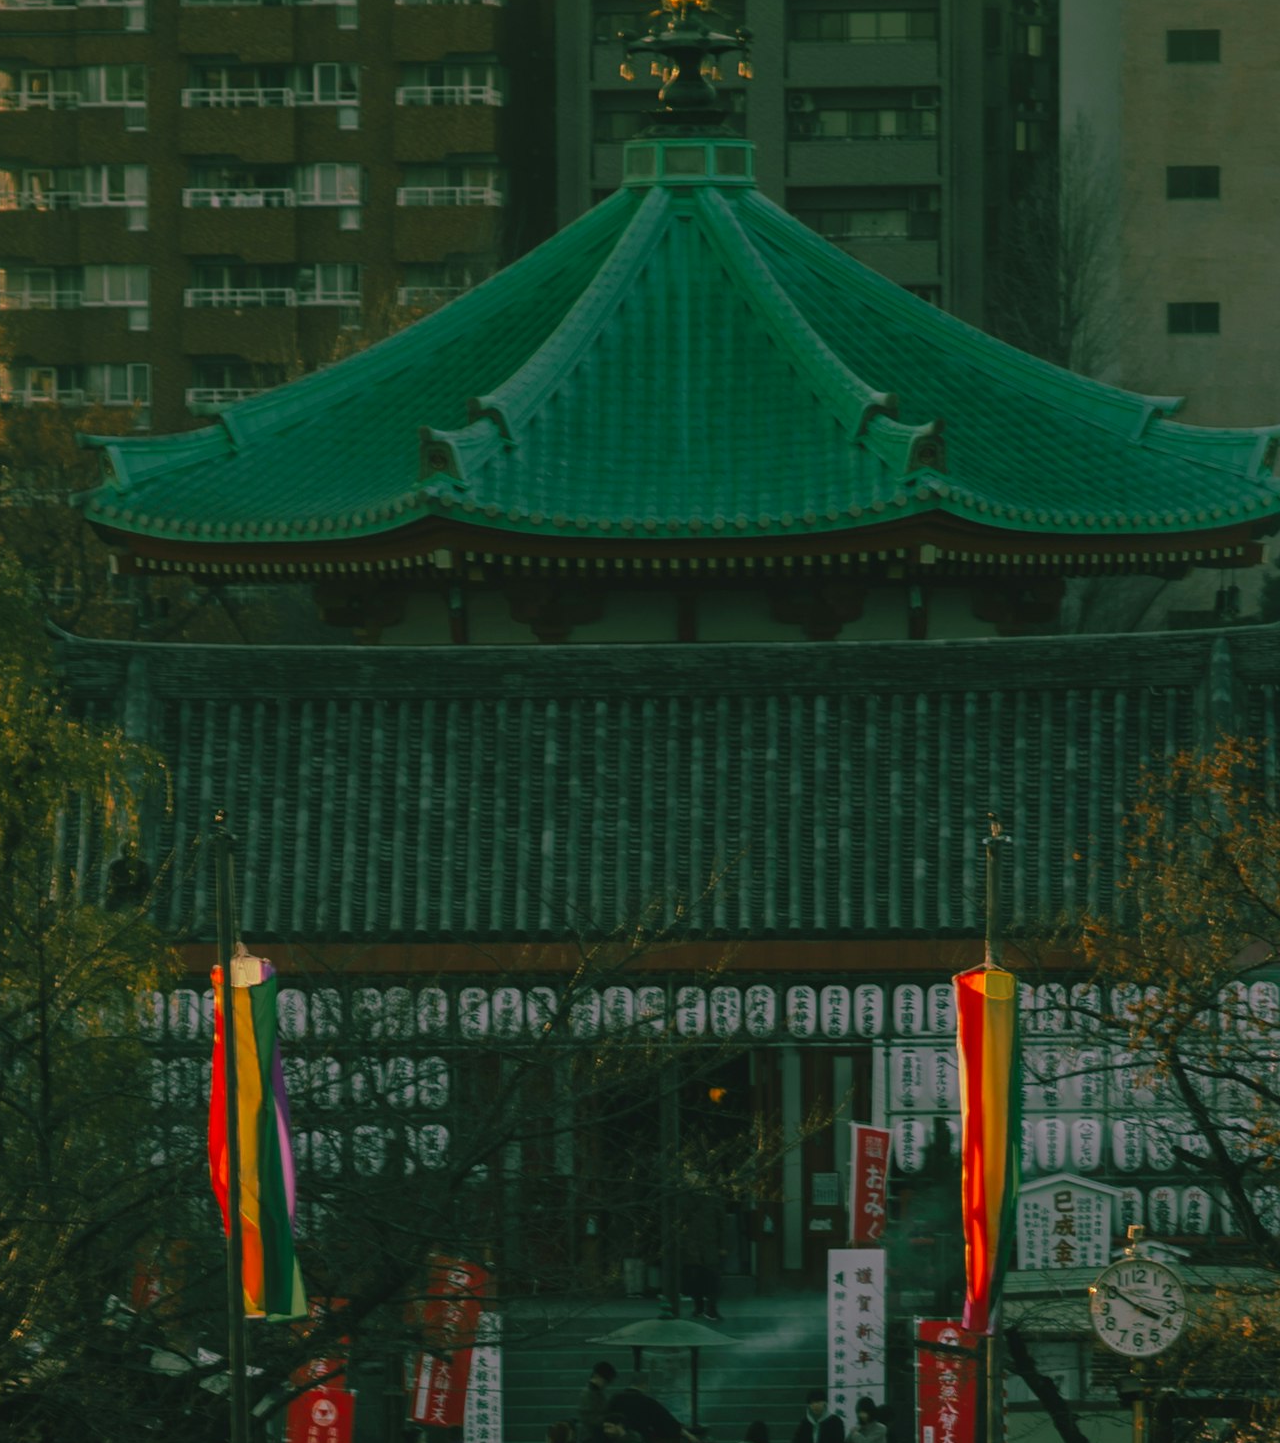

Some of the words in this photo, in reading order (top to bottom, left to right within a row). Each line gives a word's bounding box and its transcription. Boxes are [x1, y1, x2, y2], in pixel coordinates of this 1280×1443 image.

[1118, 1272, 1128, 1286] 11
[1132, 1269, 1146, 1283] 12
[1154, 1273, 1158, 1286] 1
[1162, 1284, 1172, 1298] 2
[1100, 1302, 1111, 1316] 9
[1167, 1300, 1178, 1314] 3
[855, 1266, 875, 1369] 謹賀新年
[1105, 1316, 1116, 1331] 8
[1161, 1317, 1173, 1329] 4
[1118, 1330, 1128, 1343] 7
[1132, 1333, 1144, 1347] 6
[1149, 1329, 1161, 1343] 5
